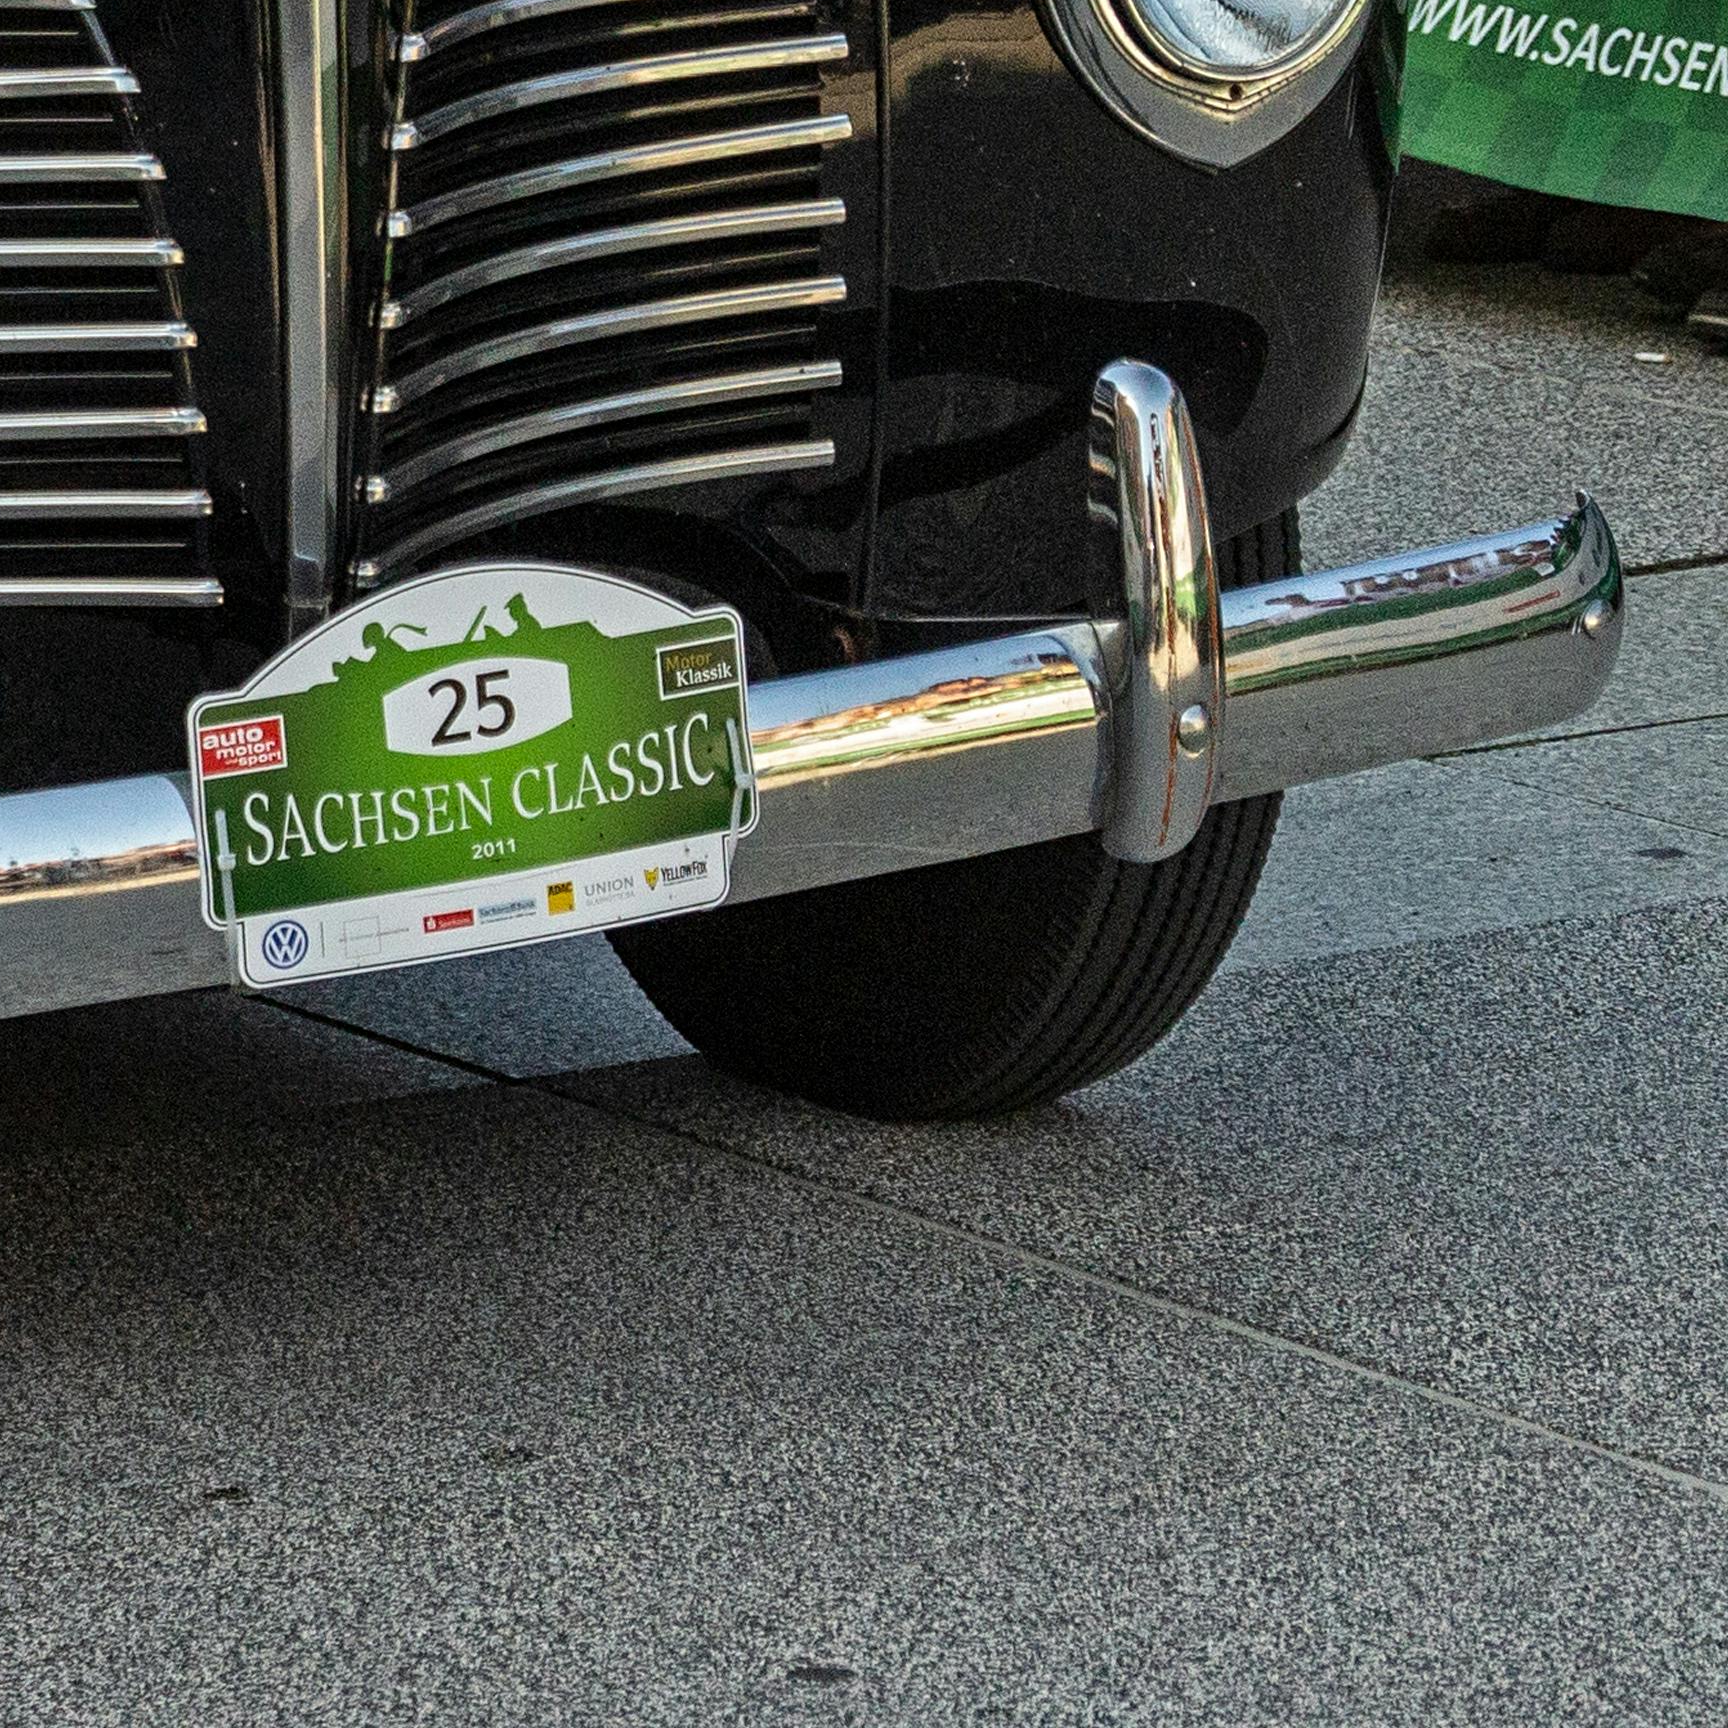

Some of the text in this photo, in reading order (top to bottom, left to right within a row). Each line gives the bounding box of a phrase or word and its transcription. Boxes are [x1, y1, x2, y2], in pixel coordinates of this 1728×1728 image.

[666, 652, 713, 672] Motor
[676, 662, 733, 687] Klassik
[428, 667, 517, 747] 25
[202, 727, 264, 750] auto
[216, 740, 276, 760] motor
[238, 751, 282, 767] sport
[245, 712, 715, 866] SACHSEN CLASSIC
[471, 839, 518, 861] 2011
[547, 882, 573, 896] ADAC
[584, 876, 635, 897] UNION
